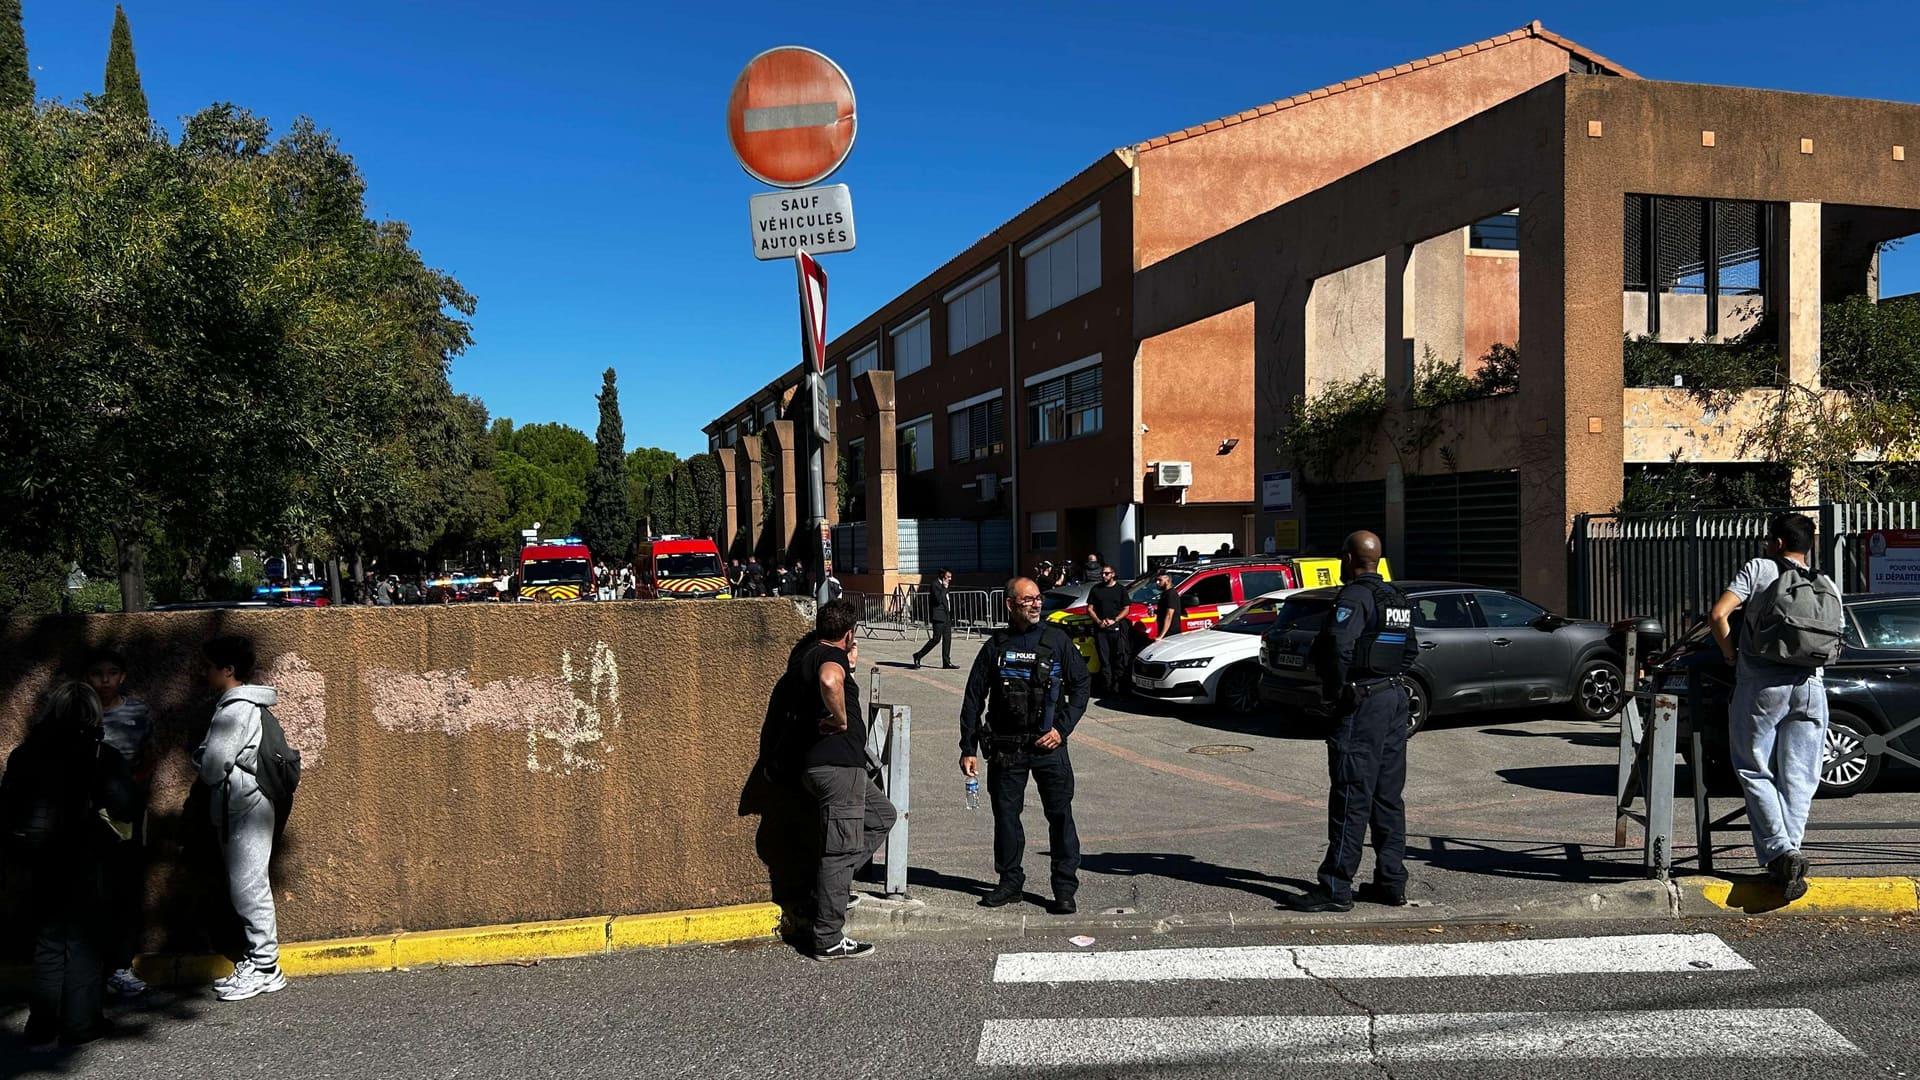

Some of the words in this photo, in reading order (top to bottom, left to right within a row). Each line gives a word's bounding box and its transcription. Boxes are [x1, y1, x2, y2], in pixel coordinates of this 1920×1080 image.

[781, 196, 819, 211] SAUF
[759, 212, 843, 232] VÉHICULES
[761, 231, 847, 250] AUTORISÉS
[1875, 573, 1884, 581] LE
